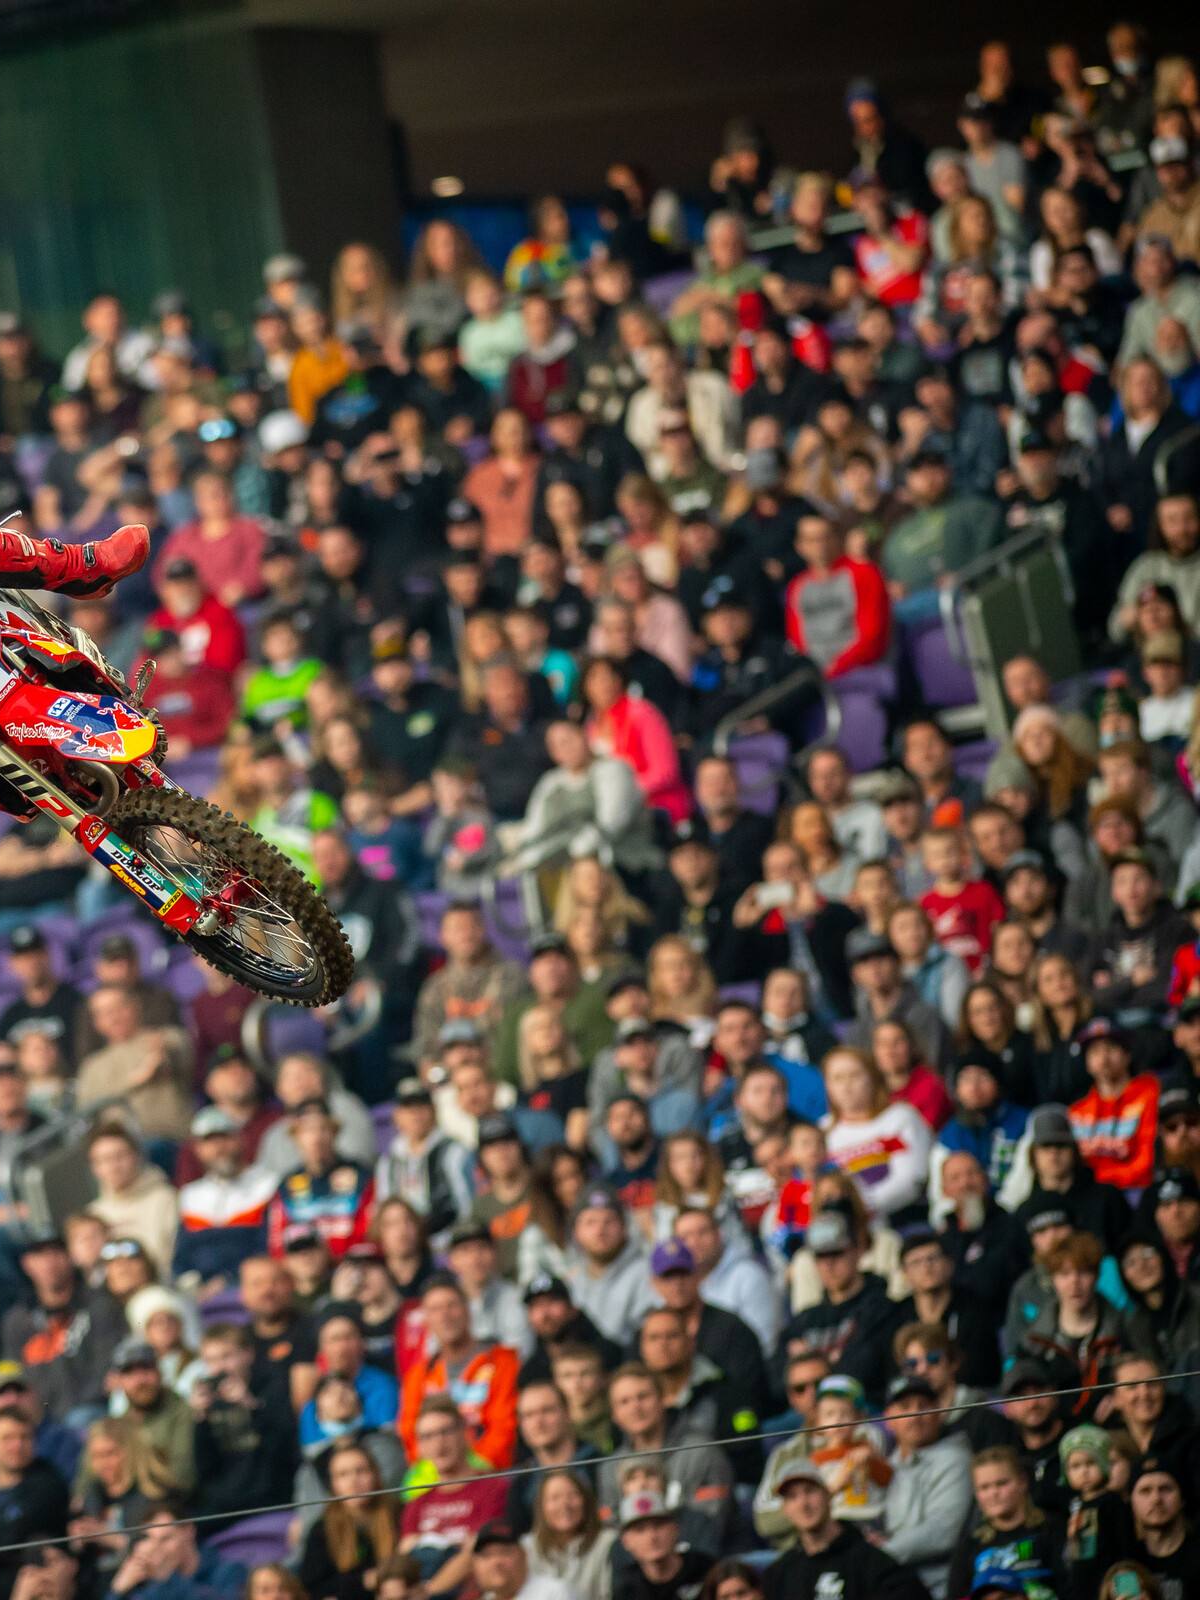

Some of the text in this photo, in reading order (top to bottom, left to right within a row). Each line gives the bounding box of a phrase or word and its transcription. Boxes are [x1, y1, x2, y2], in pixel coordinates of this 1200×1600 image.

[50, 698, 71, 717] PPG
[64, 704, 77, 717] SONY
[66, 703, 86, 723] PICTURES
[5, 723, 24, 742] Troy
[110, 849, 164, 892] DUNLOP
